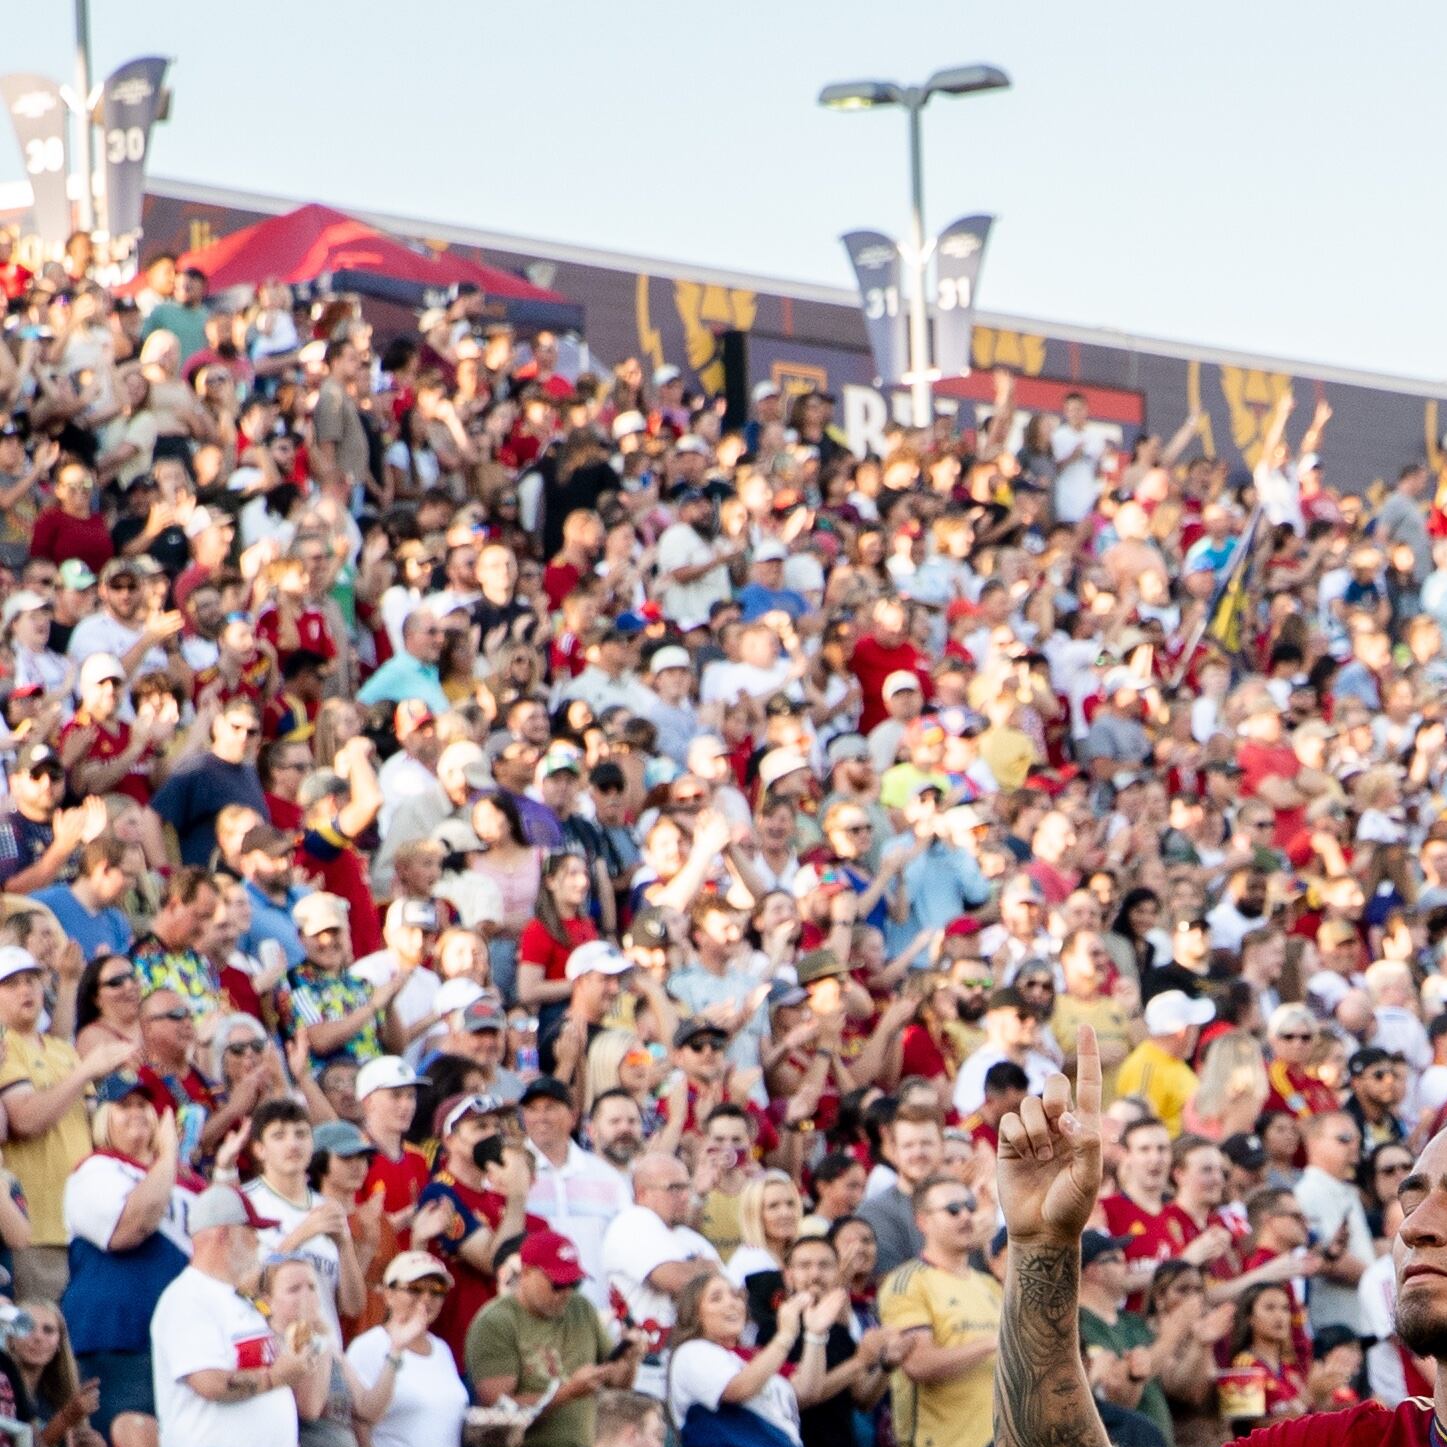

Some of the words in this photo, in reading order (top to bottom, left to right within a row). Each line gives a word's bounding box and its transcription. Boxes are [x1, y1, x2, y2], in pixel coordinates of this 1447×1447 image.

[107, 127, 145, 164] 30
[866, 286, 898, 320] 31
[937, 275, 970, 311] 31
